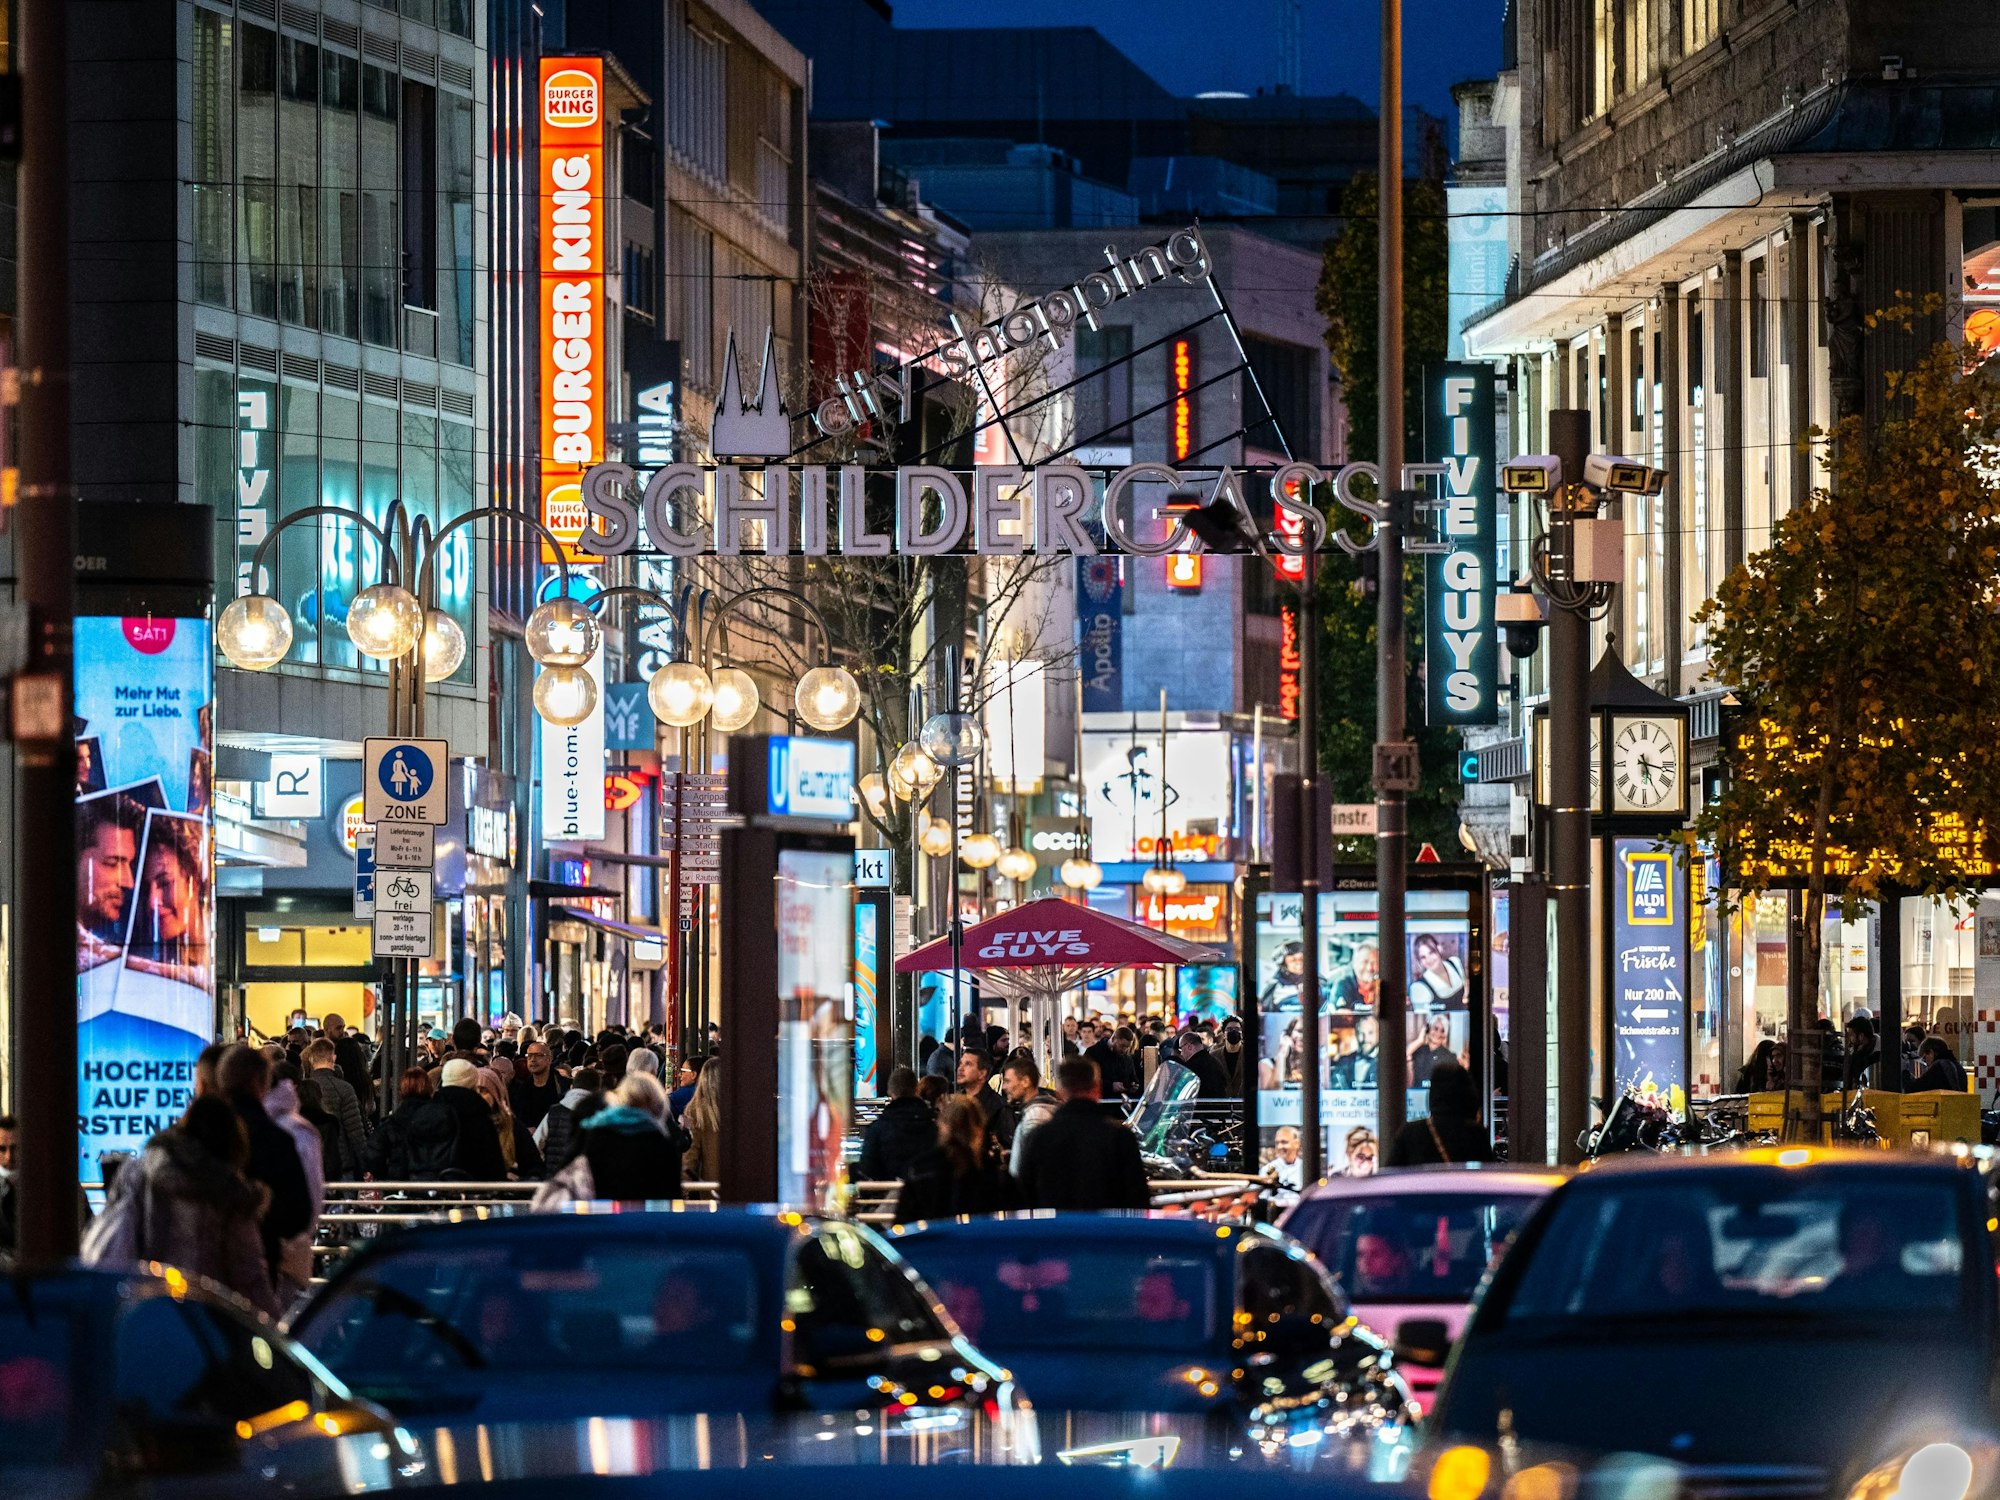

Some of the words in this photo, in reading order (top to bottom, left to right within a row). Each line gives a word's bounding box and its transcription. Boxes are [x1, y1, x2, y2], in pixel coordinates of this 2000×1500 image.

[548, 89, 594, 99] BURGER
[548, 100, 594, 114] KING
[551, 154, 592, 271] KING
[810, 363, 912, 436] city
[937, 217, 1212, 379] shopping
[552, 281, 592, 464] BURGER
[1443, 377, 1475, 536] FIVE
[550, 504, 587, 513] BURGE
[577, 462, 1457, 554] SCHILDERGASSE
[1443, 553, 1481, 711] GUYS
[115, 687, 152, 700] Mehr
[156, 687, 180, 700] Mut
[115, 707, 139, 717] zur
[143, 704, 182, 717] Liebe.
[385, 805, 427, 820] ZONE
[1333, 808, 1371, 826] instr.
[390, 828, 425, 838] Lieferfahrzeuge
[696, 825, 713, 833] VHS
[856, 859, 883, 879] rkt
[394, 900, 412, 910] frei
[1635, 894, 1665, 907] ALDI
[394, 933, 404, 941] und
[992, 929, 1082, 945] FIVE
[978, 942, 1090, 959] GUYS
[1621, 946, 1677, 972] Frische
[1625, 988, 1644, 1001] Nur
[1645, 988, 1664, 1001] 200
[1671, 1027, 1680, 1036] 31
[93, 1087, 149, 1109] AUF
[1332, 1097, 1347, 1106] die
[1350, 1098, 1371, 1107] Zeit
[1336, 1109, 1361, 1118] noch
[78, 1114, 162, 1136] RSTEN
